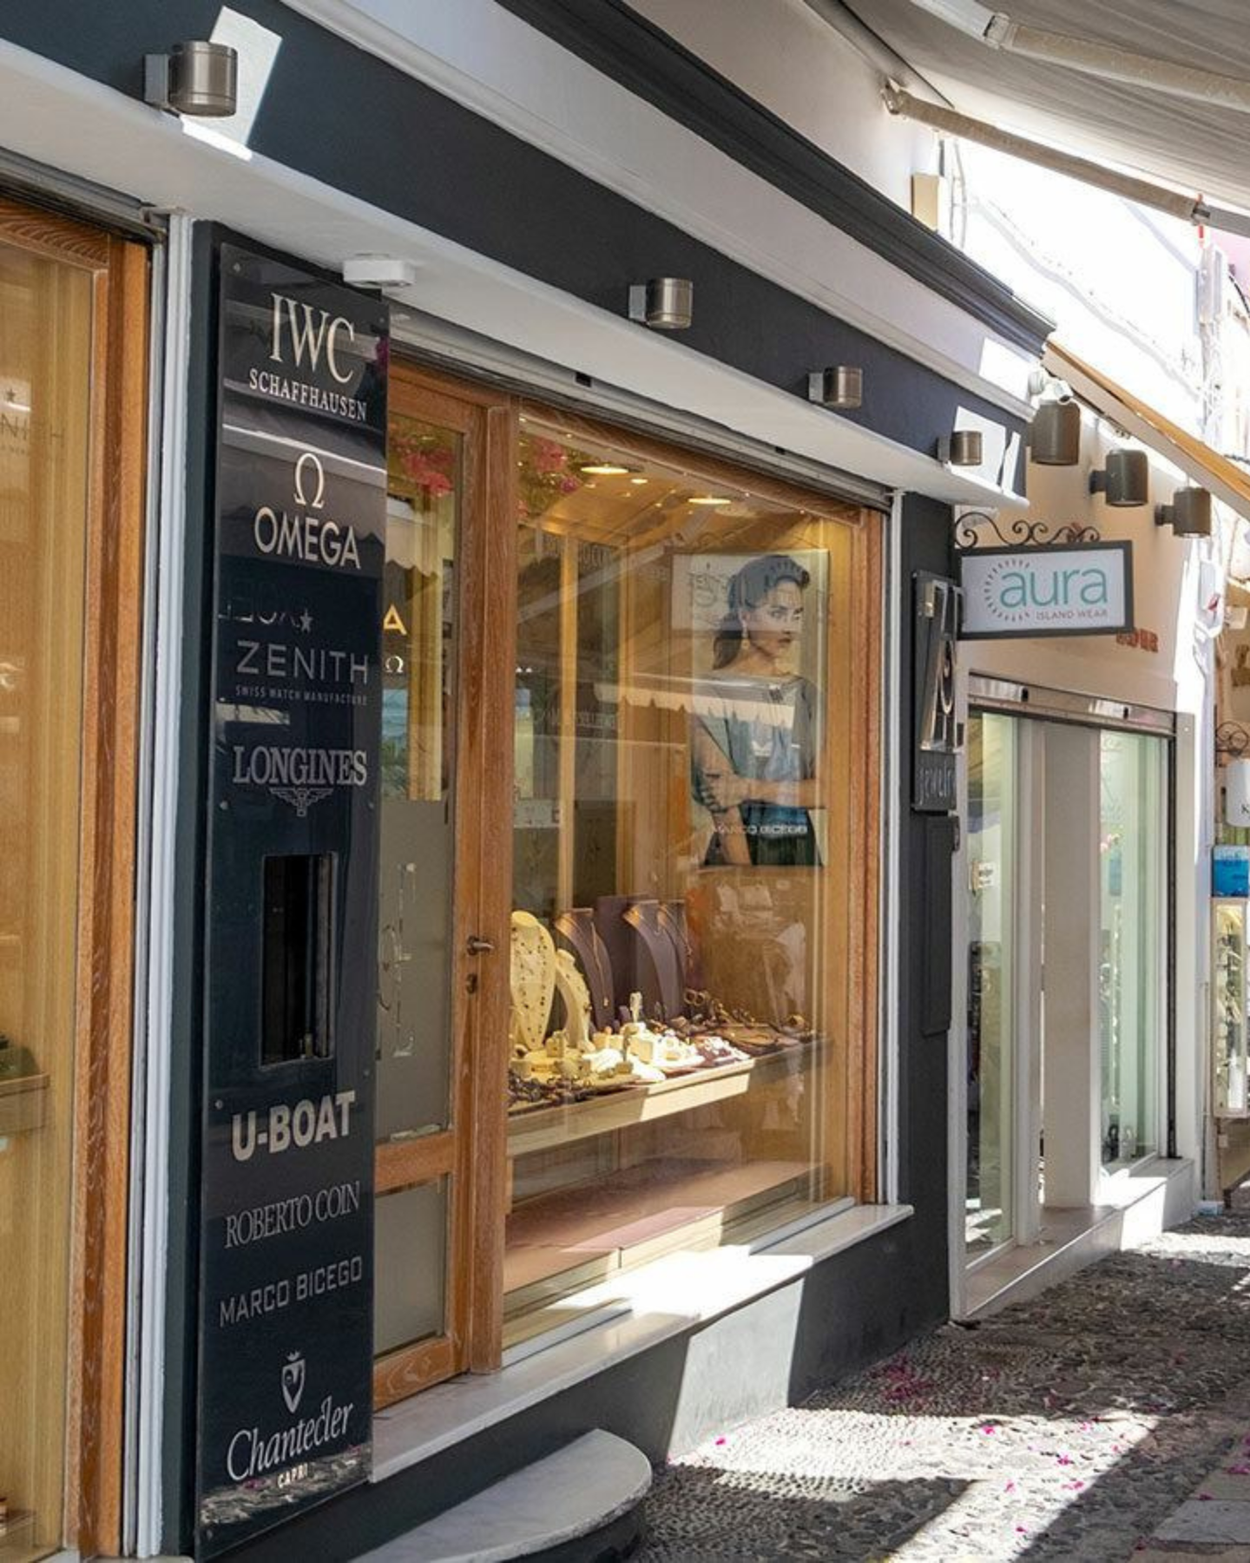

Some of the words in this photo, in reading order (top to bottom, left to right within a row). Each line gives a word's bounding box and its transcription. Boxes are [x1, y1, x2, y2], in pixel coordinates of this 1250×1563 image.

[269, 292, 355, 384] IWC
[248, 367, 368, 422] SCHAFFHAUSEN
[254, 505, 362, 570] OMEGA
[1000, 568, 1109, 610] aura
[1036, 610, 1074, 621] ISLAND
[1077, 609, 1109, 619] WEAR
[236, 639, 369, 685] ZENITH
[235, 684, 266, 698] SWISS
[269, 687, 301, 701] WATCH
[232, 745, 369, 786] LONGINES
[231, 1090, 356, 1163] U-BOAT
[223, 1195, 314, 1249] ROBERTO
[314, 1180, 362, 1224] COIN
[218, 1280, 290, 1328] MARCO
[296, 1255, 363, 1301] BICEGO
[226, 1395, 355, 1483] Chantecler
